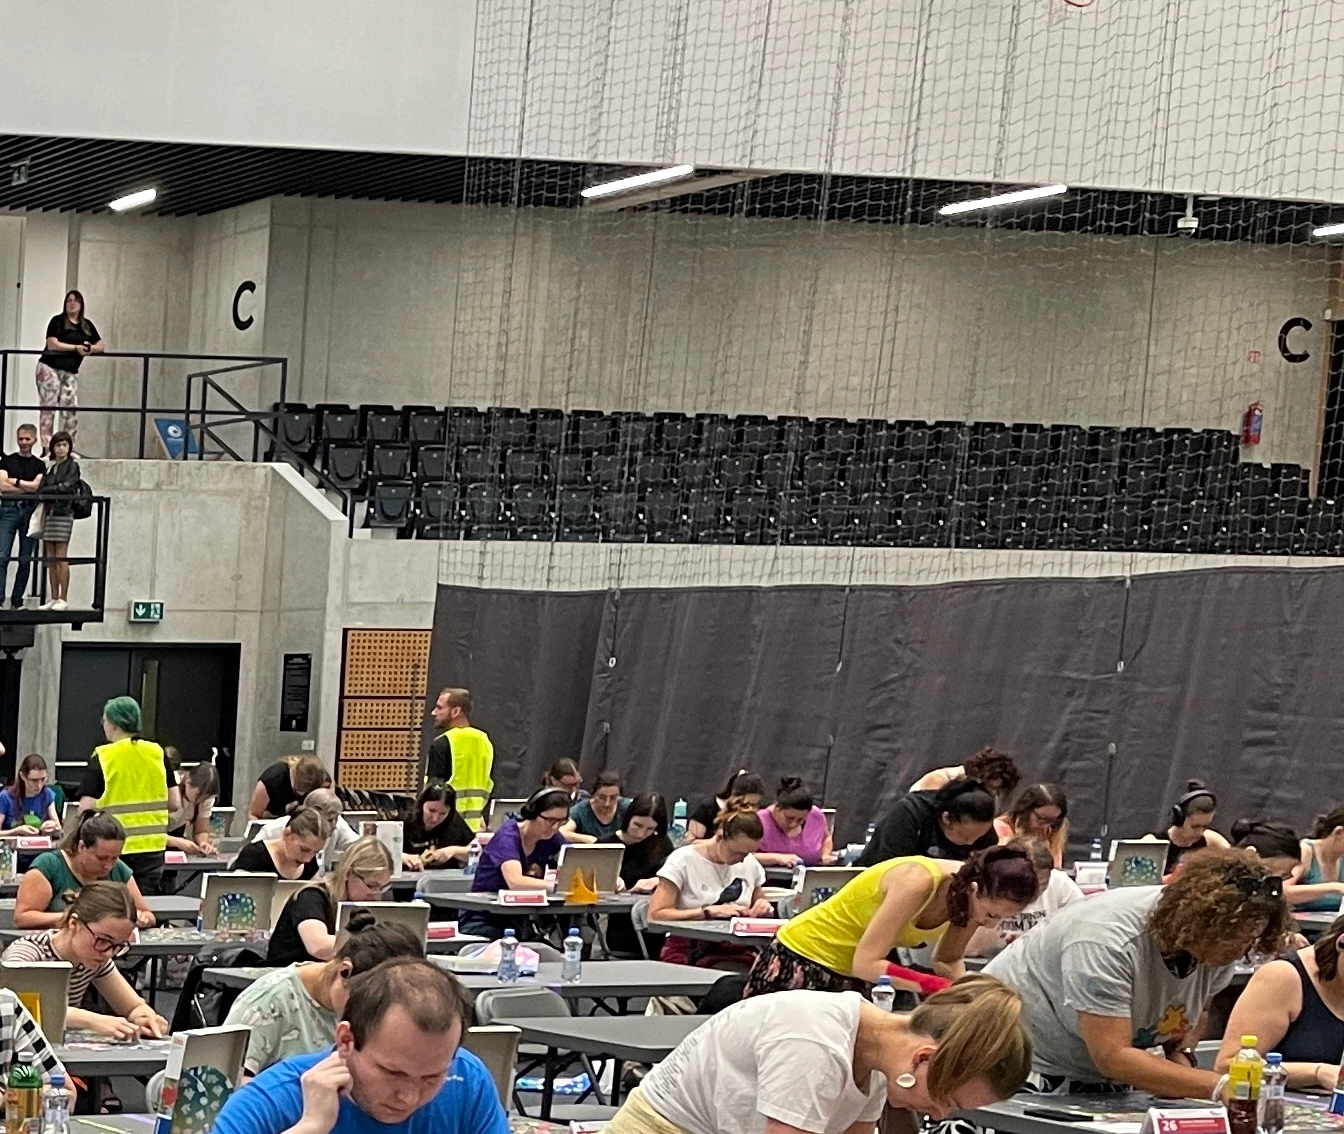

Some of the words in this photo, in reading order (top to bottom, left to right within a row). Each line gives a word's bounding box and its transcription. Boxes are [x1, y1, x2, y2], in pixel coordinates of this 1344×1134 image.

[232, 280, 257, 331] C
[1277, 317, 1313, 363] C
[1161, 1119, 1178, 1132] 26
